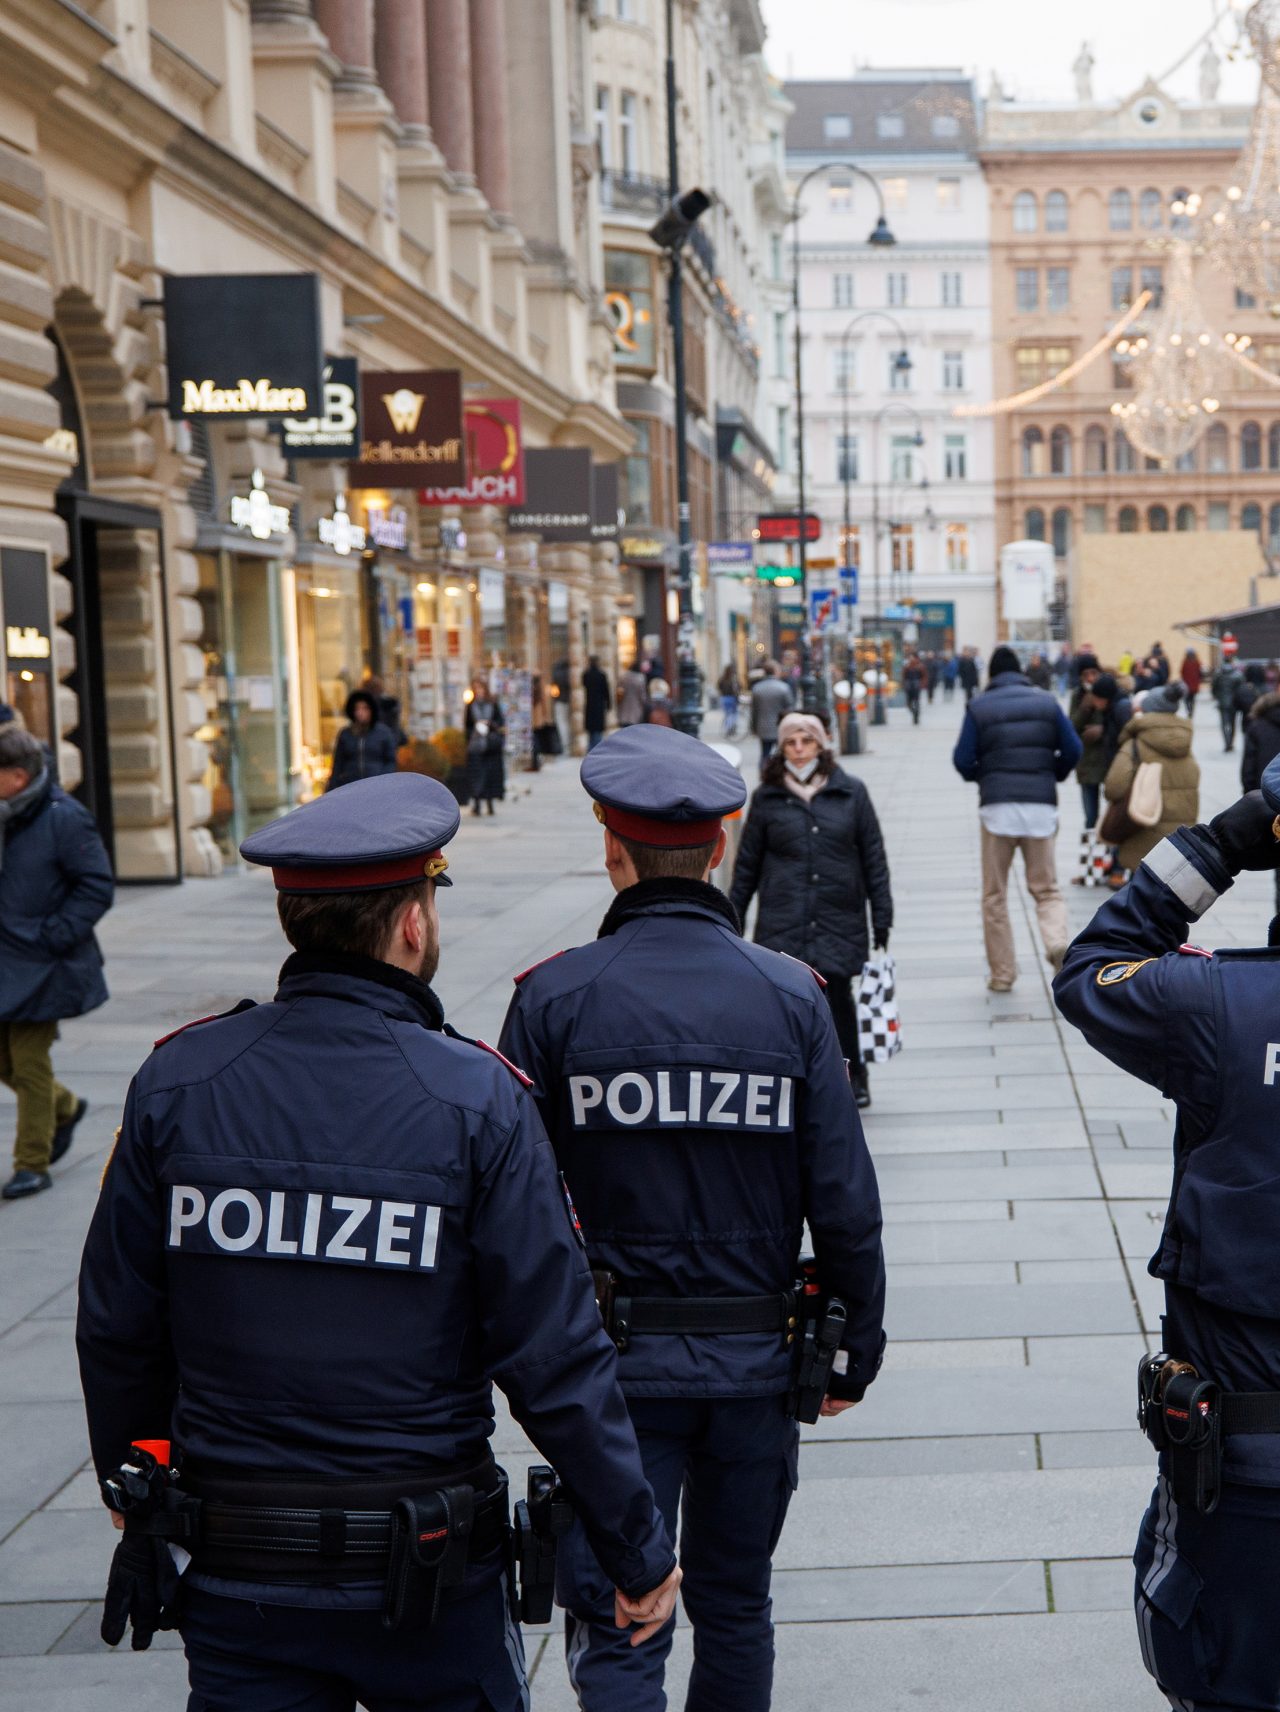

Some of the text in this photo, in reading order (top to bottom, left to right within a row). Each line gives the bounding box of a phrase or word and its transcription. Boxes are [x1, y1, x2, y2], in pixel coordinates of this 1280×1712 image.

[182, 378, 307, 413] MaxMara
[569, 1071, 793, 1128] POLIZEI
[168, 1184, 444, 1268] POLIZEI
